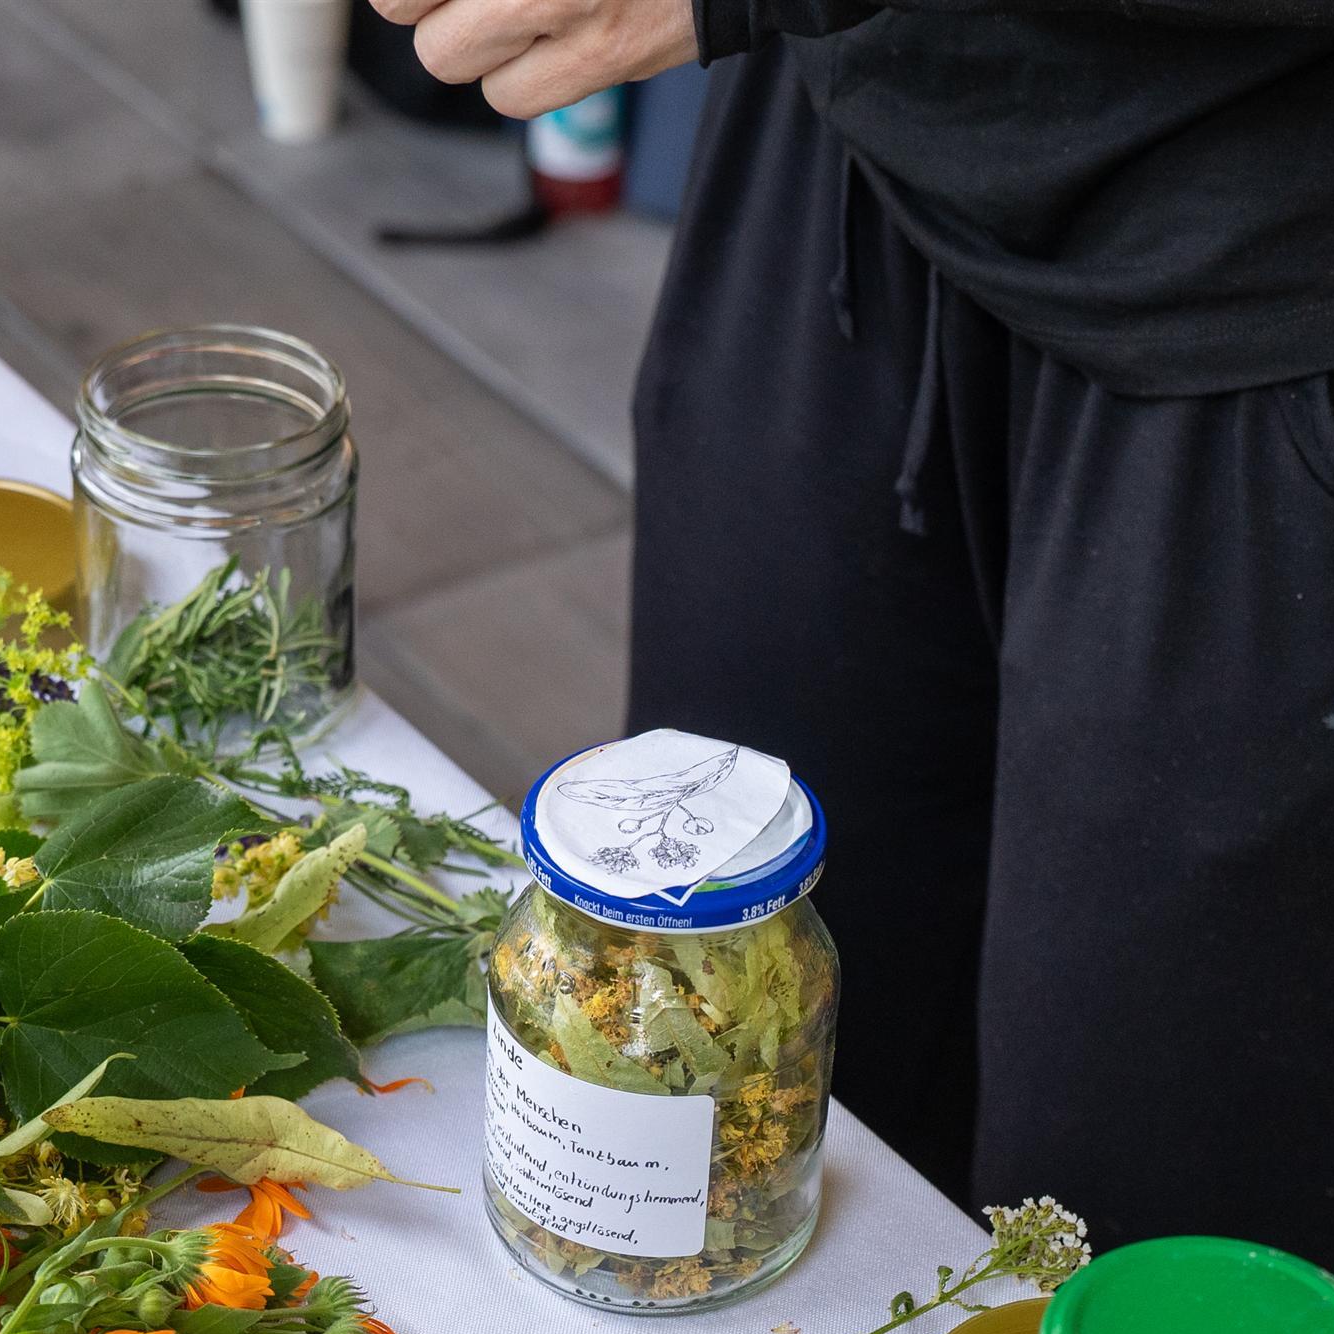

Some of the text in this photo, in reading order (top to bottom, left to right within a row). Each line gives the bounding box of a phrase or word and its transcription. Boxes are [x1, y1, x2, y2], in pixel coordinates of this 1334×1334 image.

[538, 866, 551, 889] Fett
[574, 893, 693, 928] Knackt beim ersten Öffnen!
[767, 894, 786, 913] Fett
[493, 1021, 523, 1070] Linde
[516, 1083, 582, 1135] Menschen
